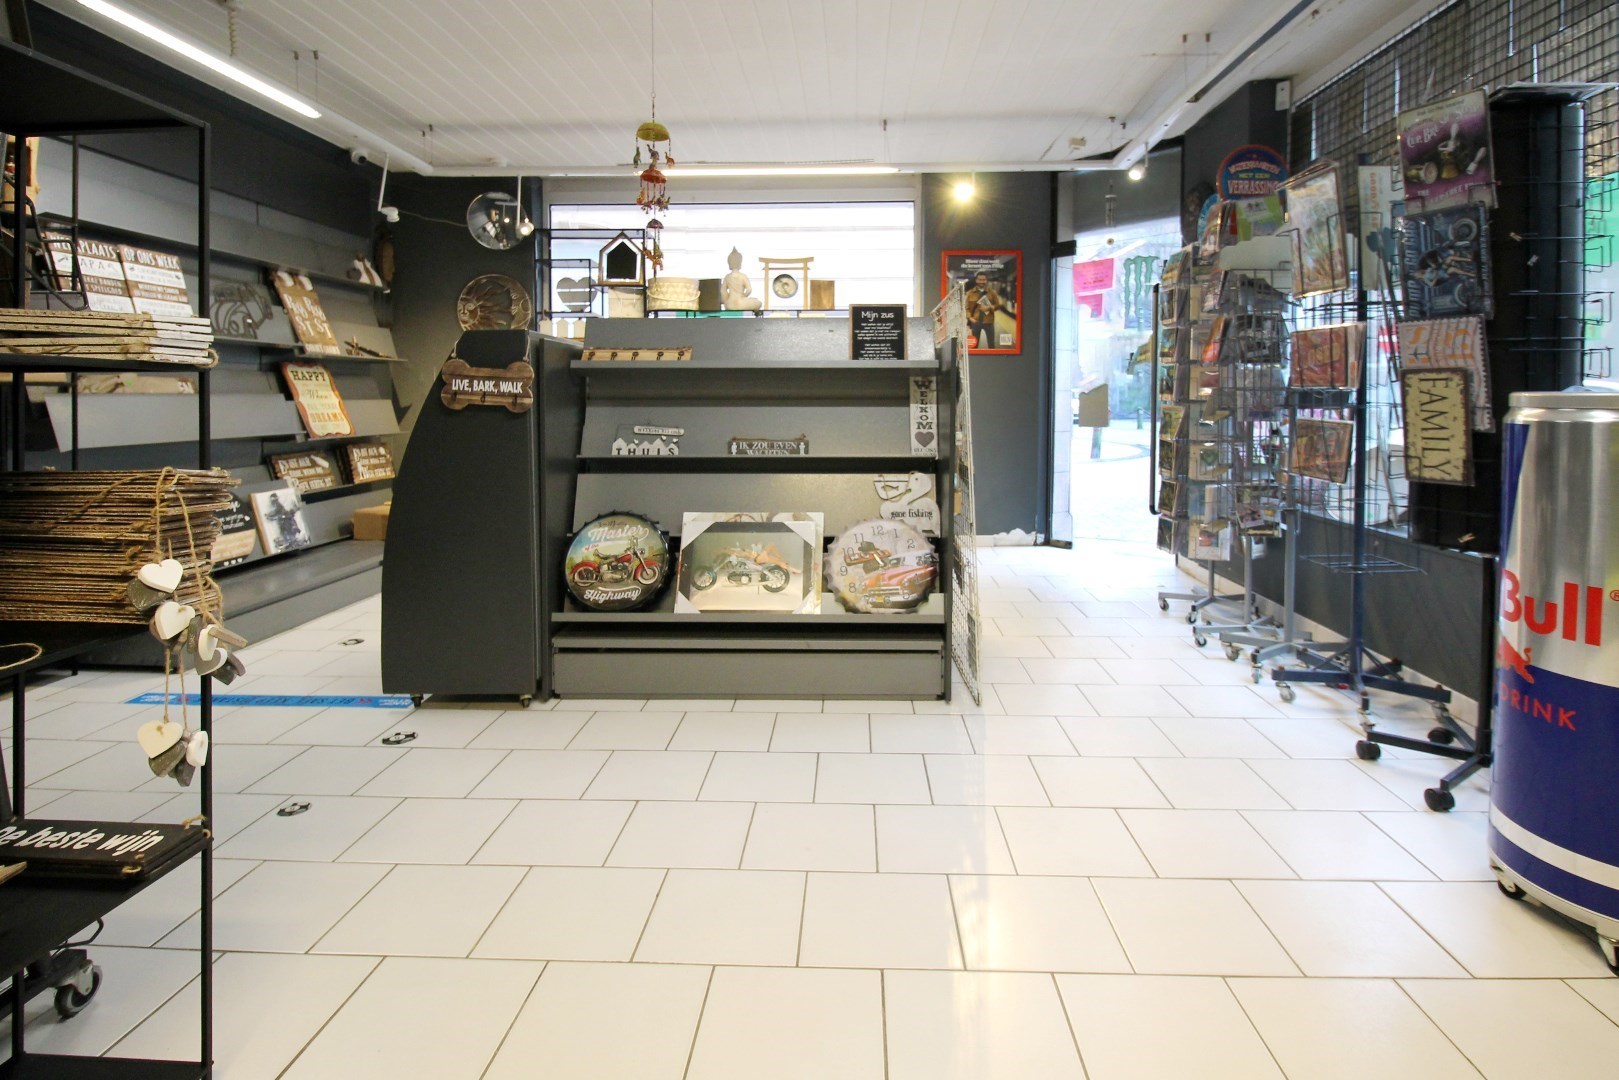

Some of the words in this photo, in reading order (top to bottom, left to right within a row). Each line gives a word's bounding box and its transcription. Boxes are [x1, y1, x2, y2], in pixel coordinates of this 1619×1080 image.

[124, 247, 138, 261] OP
[137, 250, 156, 266] ONS
[861, 311, 878, 322] Mijn
[290, 370, 326, 382] HAPPY
[452, 378, 471, 392] LIVE,
[473, 380, 497, 394] BARK,
[499, 381, 523, 394] WALK
[913, 380, 934, 430] WELKOM
[1418, 377, 1451, 476] FAMILY
[615, 447, 676, 456] THUIS
[739, 441, 749, 450] IK
[752, 441, 771, 450] ZOU
[774, 441, 798, 450] EVEN
[890, 510, 907, 520] gone
[908, 508, 934, 520] fishing
[588, 524, 650, 542] Master
[871, 525, 884, 536] 12
[893, 528, 899, 539] 1
[854, 532, 865, 544] 11
[906, 538, 916, 550] 2
[842, 547, 855, 561] 10
[839, 565, 848, 577] 9
[848, 583, 857, 593] 8
[583, 586, 642, 604] Highway
[1501, 567, 1603, 647] Bull
[1500, 685, 1577, 732] DRINK
[14, 826, 105, 850] beste
[96, 829, 165, 857] wijn
